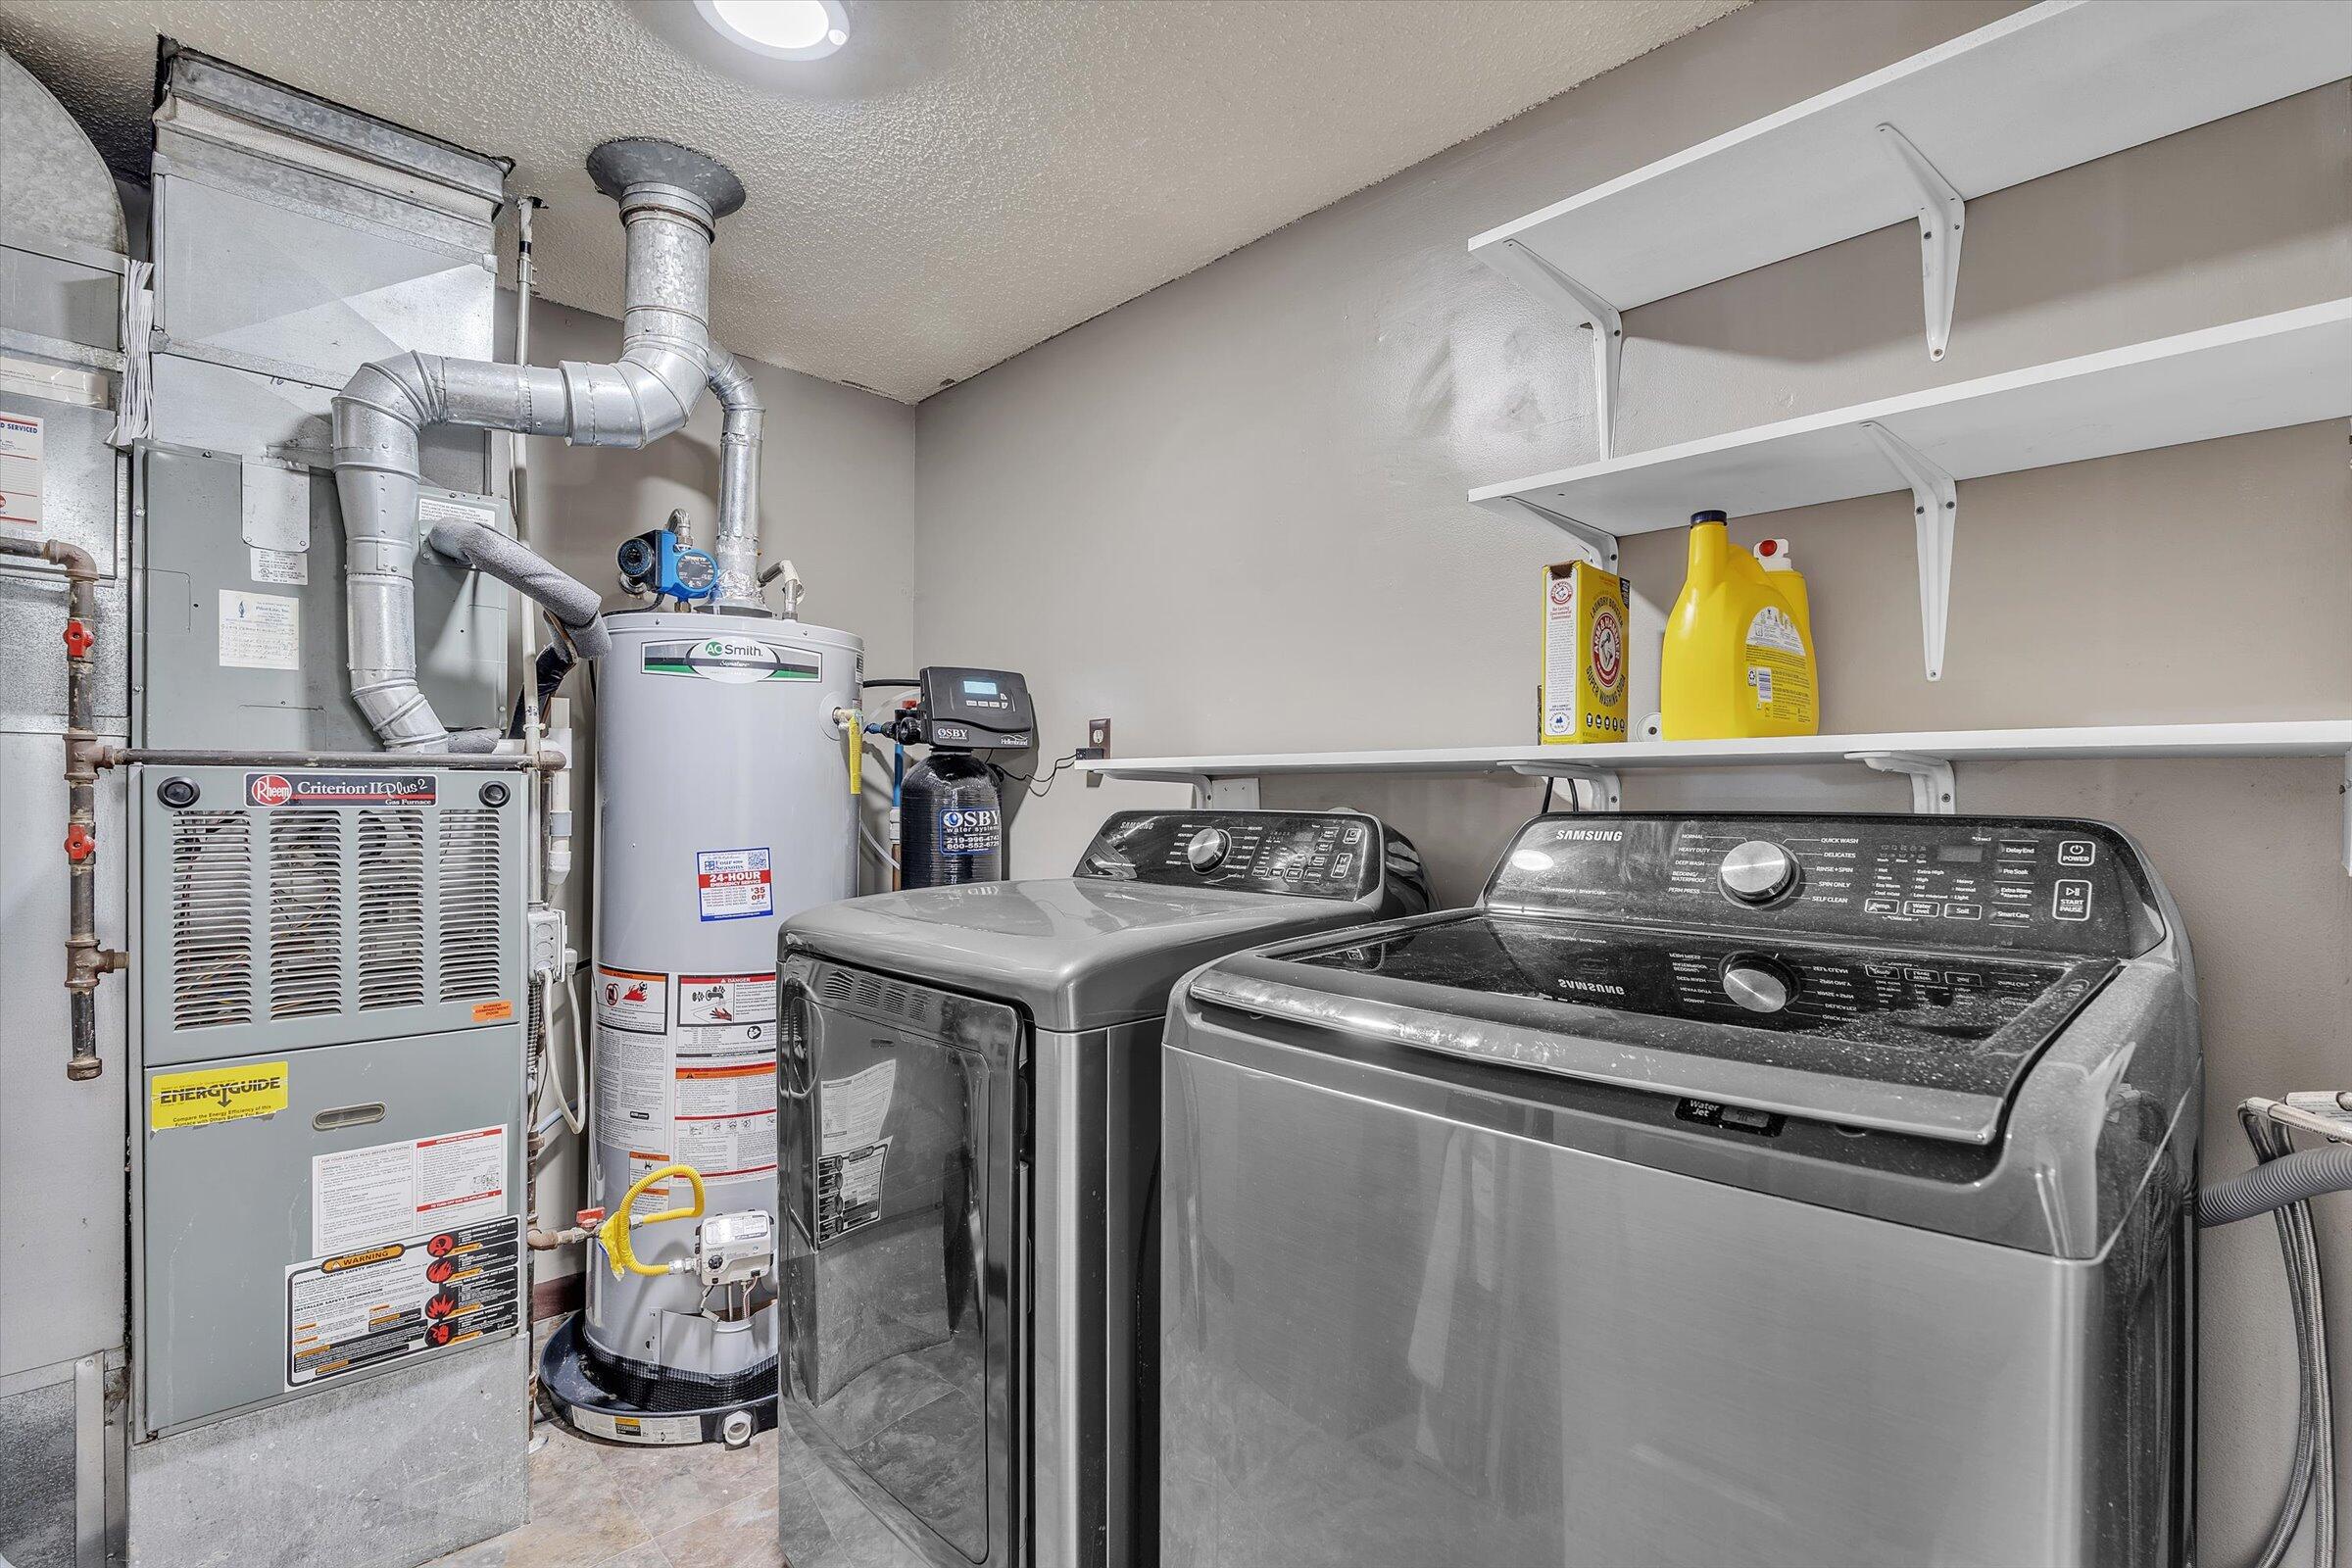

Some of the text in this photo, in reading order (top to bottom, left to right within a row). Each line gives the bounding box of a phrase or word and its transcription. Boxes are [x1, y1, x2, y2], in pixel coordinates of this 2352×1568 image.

[8, 423, 37, 434] SERVICED
[938, 728, 967, 737] OSBY
[256, 775, 291, 801] Rheem
[297, 781, 367, 795] Criterion
[943, 810, 1000, 828] OSBY
[1119, 821, 1154, 830] SAMSUNG
[1556, 830, 1623, 842] SAMSUNG
[709, 871, 761, 883] 24-HOUR
[160, 1077, 281, 1104] ENERGYGUIDE
[1690, 1100, 1720, 1111] Water
[173, 1114, 198, 1123] Compare
[209, 1111, 227, 1120] Energy
[228, 1107, 254, 1116] Efficiency
[1692, 1107, 1710, 1117] Jet
[343, 1250, 389, 1266] WARNING
[367, 1258, 402, 1269] INFORMATION
[294, 1288, 383, 1312] INSTALLER SAFETY INFORMATION
